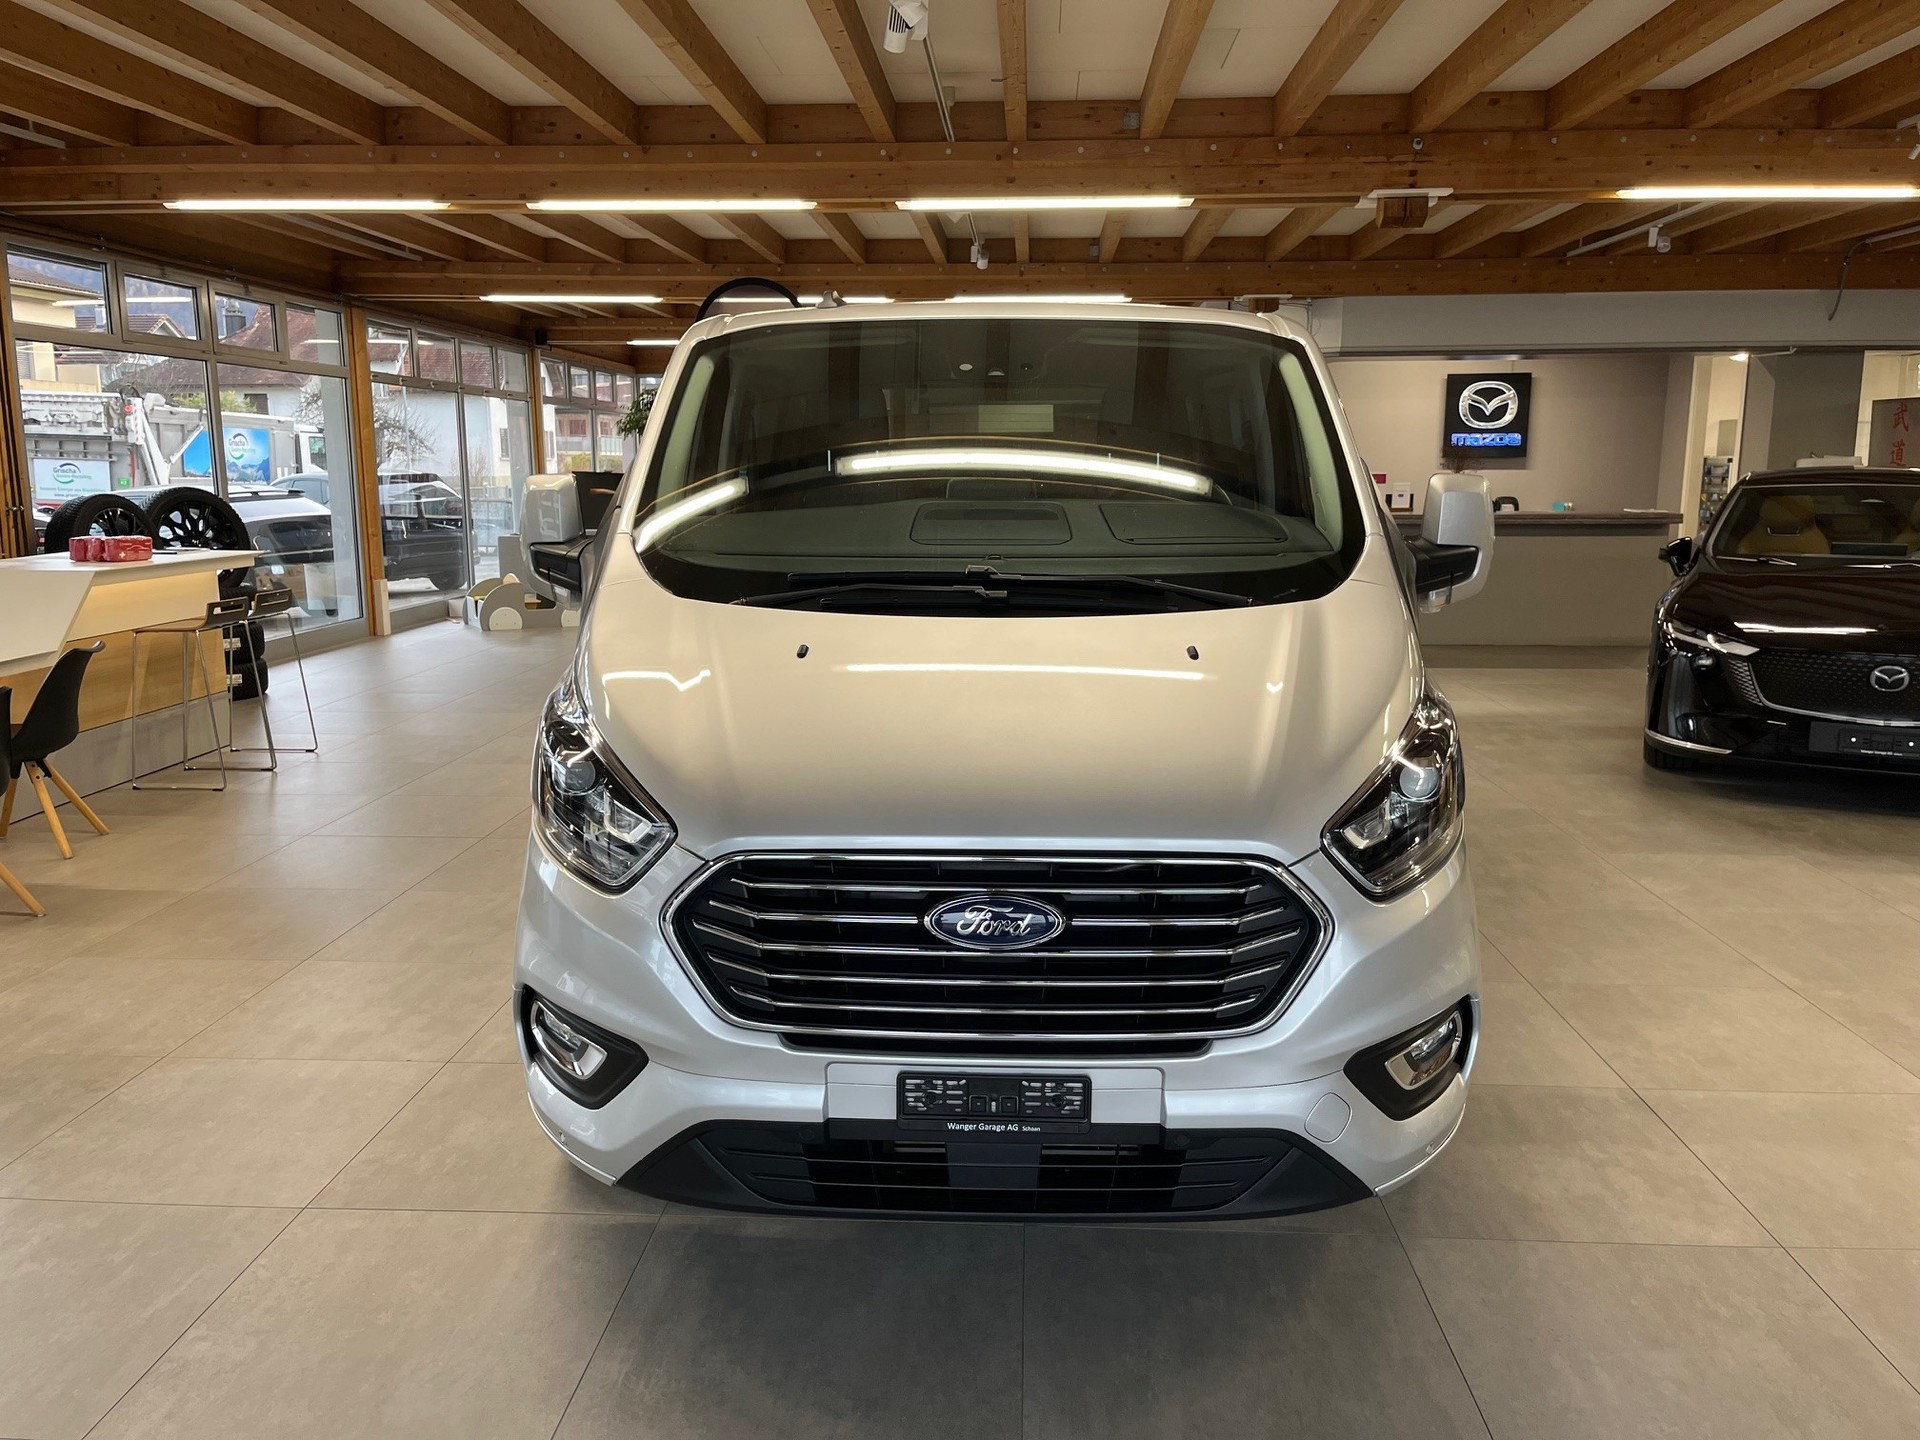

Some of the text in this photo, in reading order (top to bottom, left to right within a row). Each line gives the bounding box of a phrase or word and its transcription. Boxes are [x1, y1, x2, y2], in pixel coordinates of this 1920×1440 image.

[956, 905, 1032, 936] Ford
[947, 1122, 976, 1132] Wanger
[978, 1123, 1006, 1133] Garage
[1006, 1124, 1019, 1132] AG
